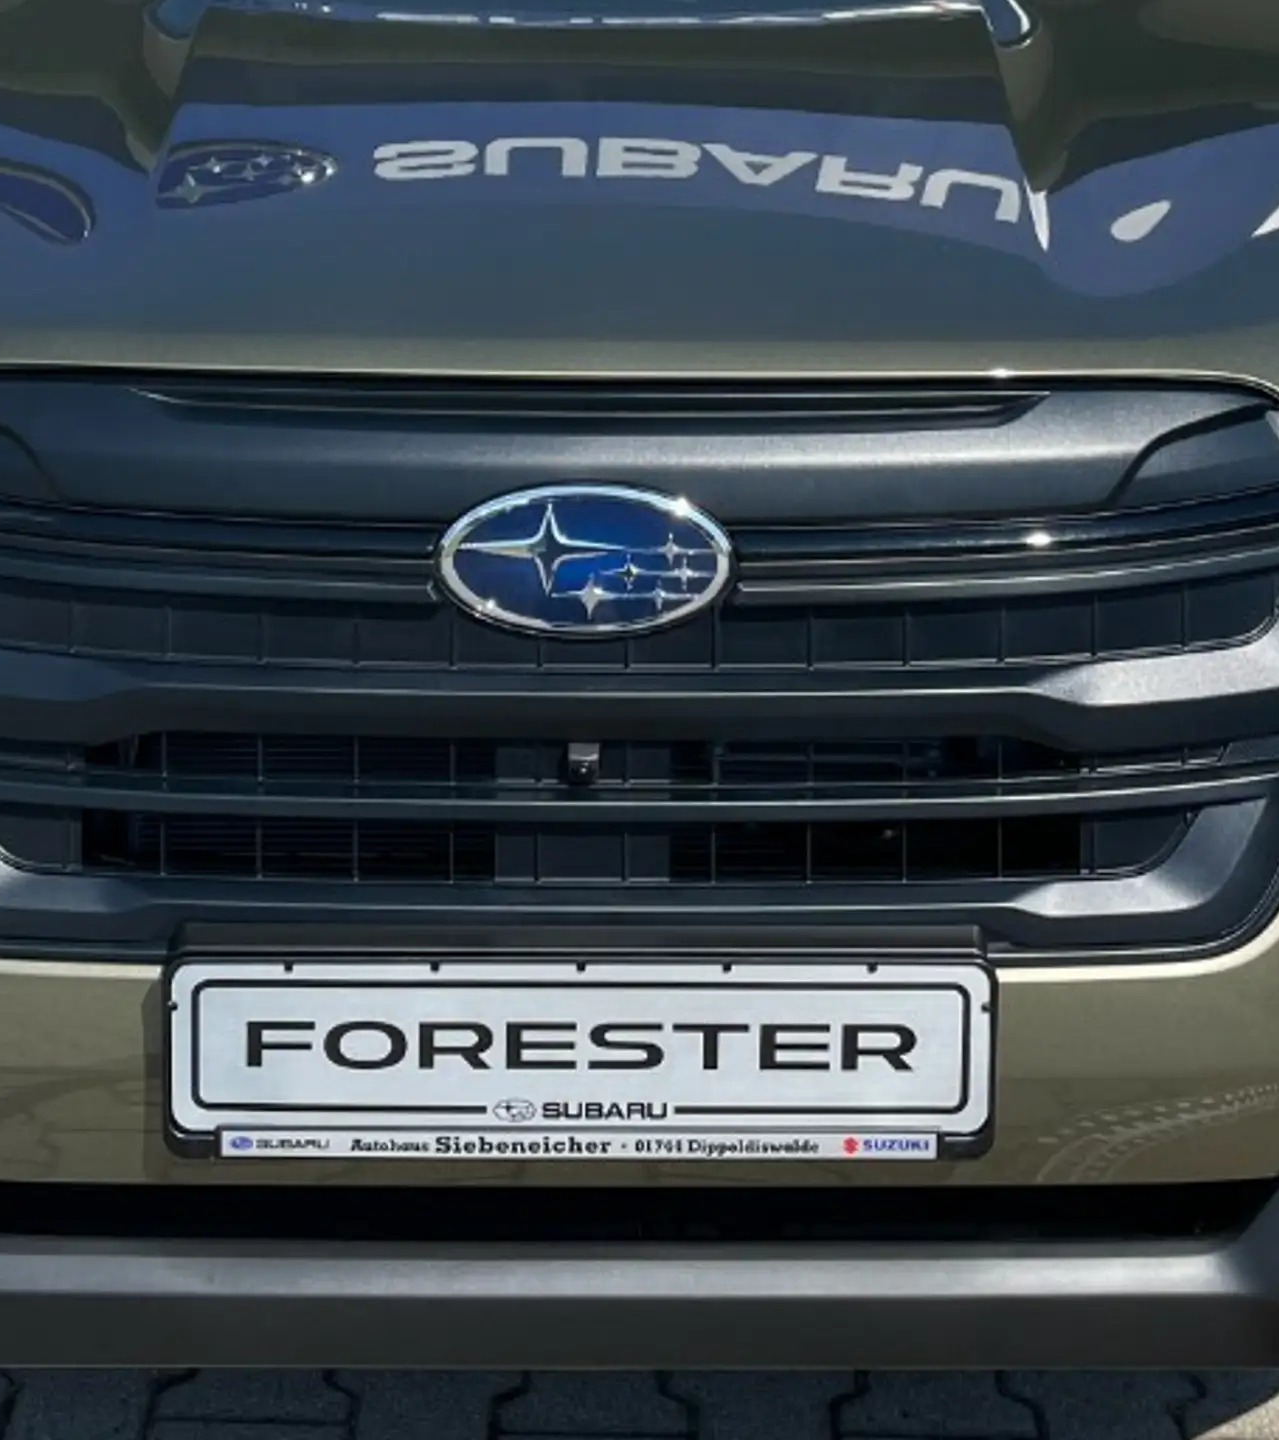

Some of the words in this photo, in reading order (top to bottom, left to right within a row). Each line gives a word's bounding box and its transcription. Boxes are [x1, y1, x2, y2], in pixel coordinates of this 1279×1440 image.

[246, 1020, 919, 1071] FORESTER
[542, 1101, 668, 1120] SUBARU
[351, 1138, 429, 1152] Autohaus
[435, 1136, 612, 1154] Siebeneicher
[863, 1139, 929, 1152] SUZUKI
